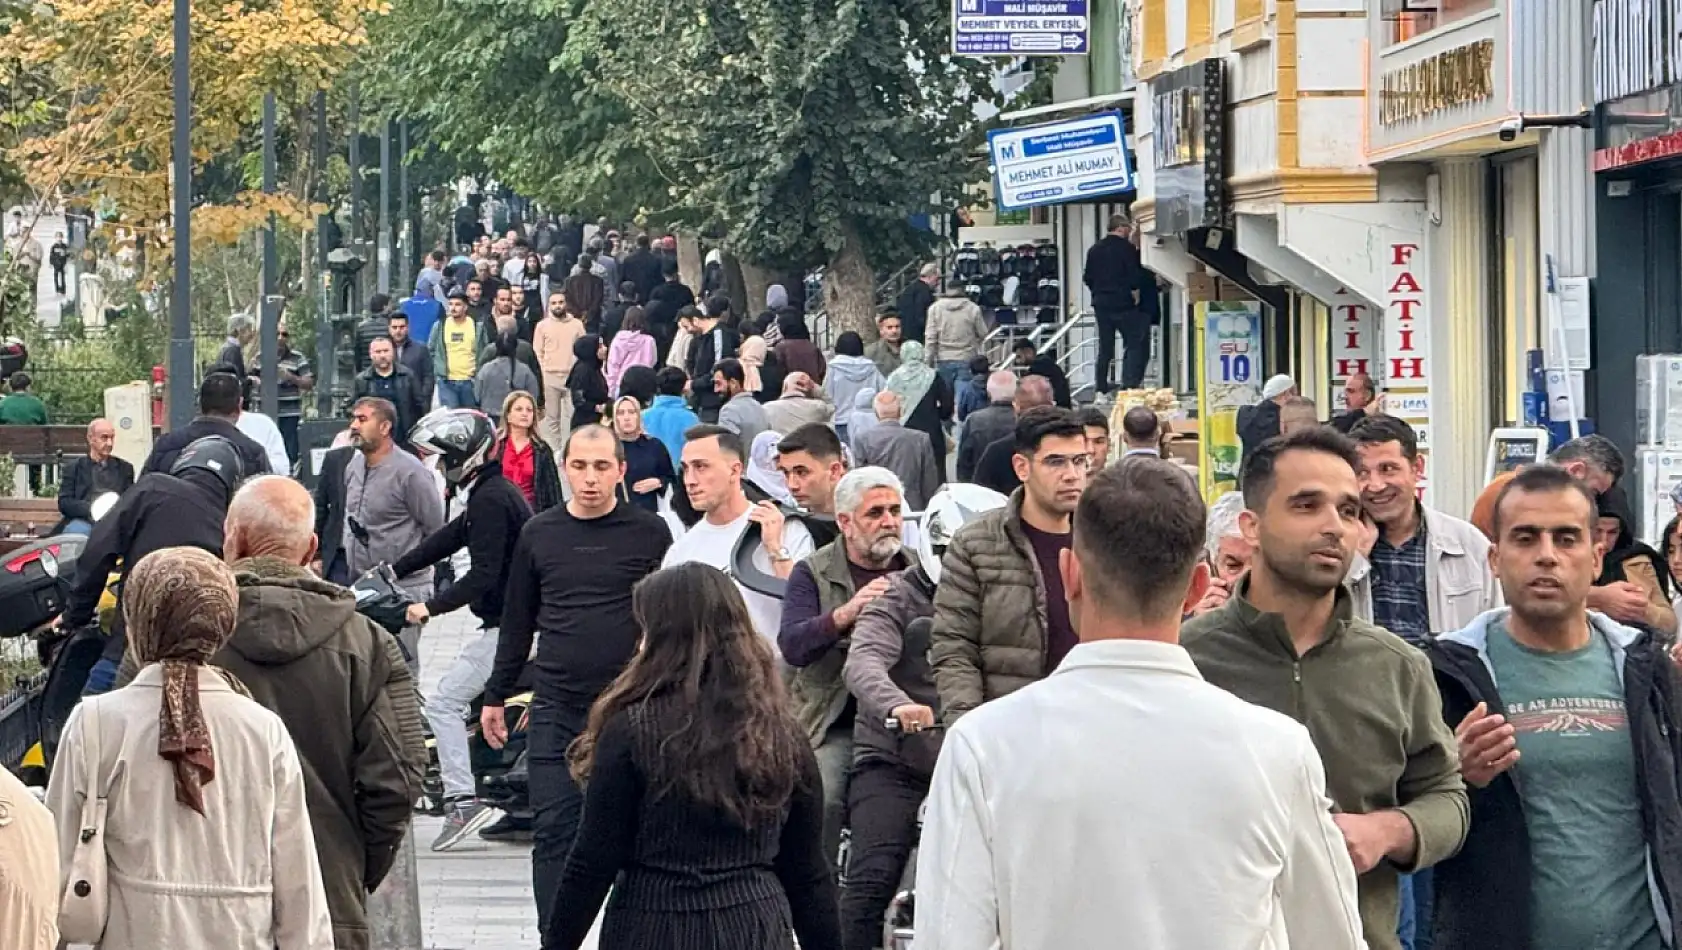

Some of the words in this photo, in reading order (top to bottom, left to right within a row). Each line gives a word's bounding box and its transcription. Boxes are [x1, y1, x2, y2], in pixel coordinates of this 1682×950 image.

[1003, 3, 1025, 13] MALİ
[1028, 2, 1068, 14] MÜŞAVİR
[961, 20, 1000, 29] MEHMET
[1003, 20, 1040, 29] VEYSEL
[1043, 18, 1081, 31] ERYEŞİL
[1008, 165, 1054, 183] MEHMET
[1056, 160, 1073, 175] ALİ
[1076, 155, 1115, 172] MUMAY
[1388, 243, 1425, 379] FATİH
[1220, 342, 1249, 354] SU
[1219, 354, 1250, 382] 10
[1508, 703, 1525, 714] BE
[1529, 699, 1546, 711] AN
